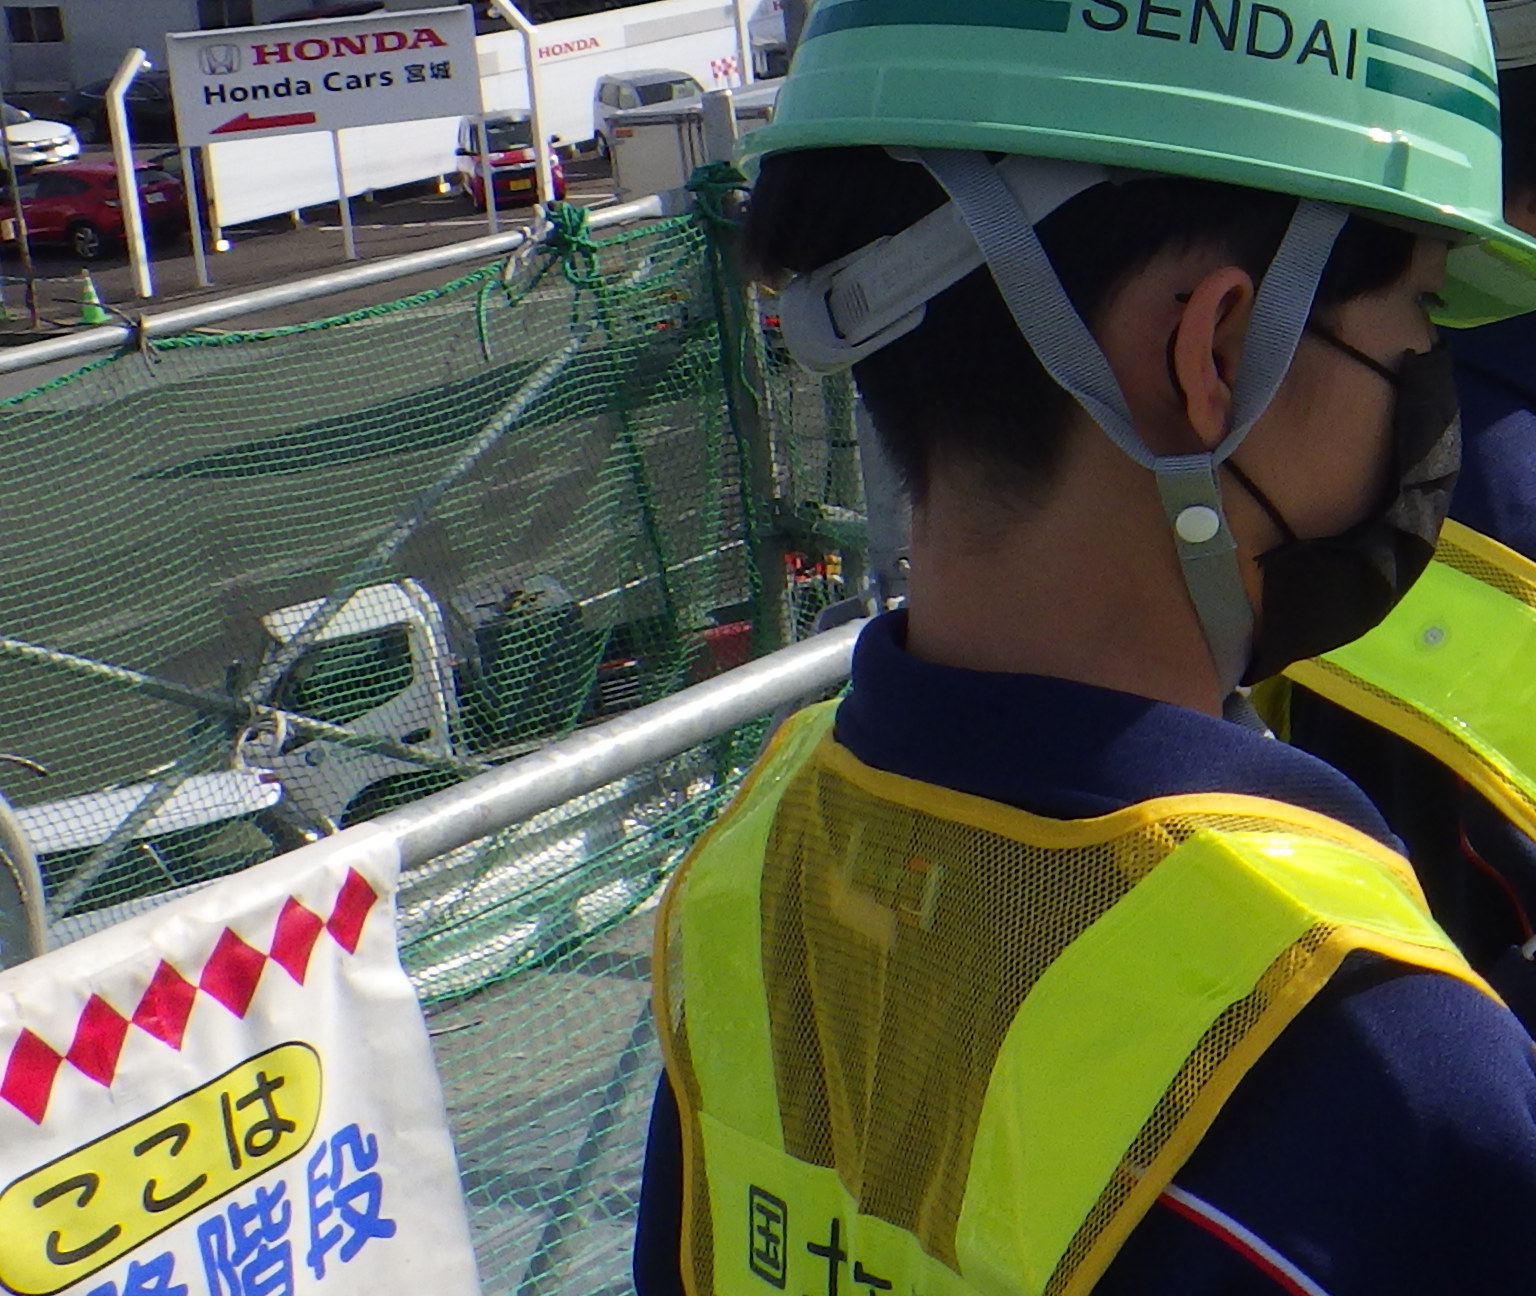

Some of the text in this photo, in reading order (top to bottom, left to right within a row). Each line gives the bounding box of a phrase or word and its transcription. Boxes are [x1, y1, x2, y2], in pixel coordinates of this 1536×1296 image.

[252, 28, 447, 66] HONDA
[538, 36, 600, 59] HONDA
[203, 76, 312, 105] Honda
[323, 70, 394, 92] Cars
[33, 1070, 296, 1266] ここは
